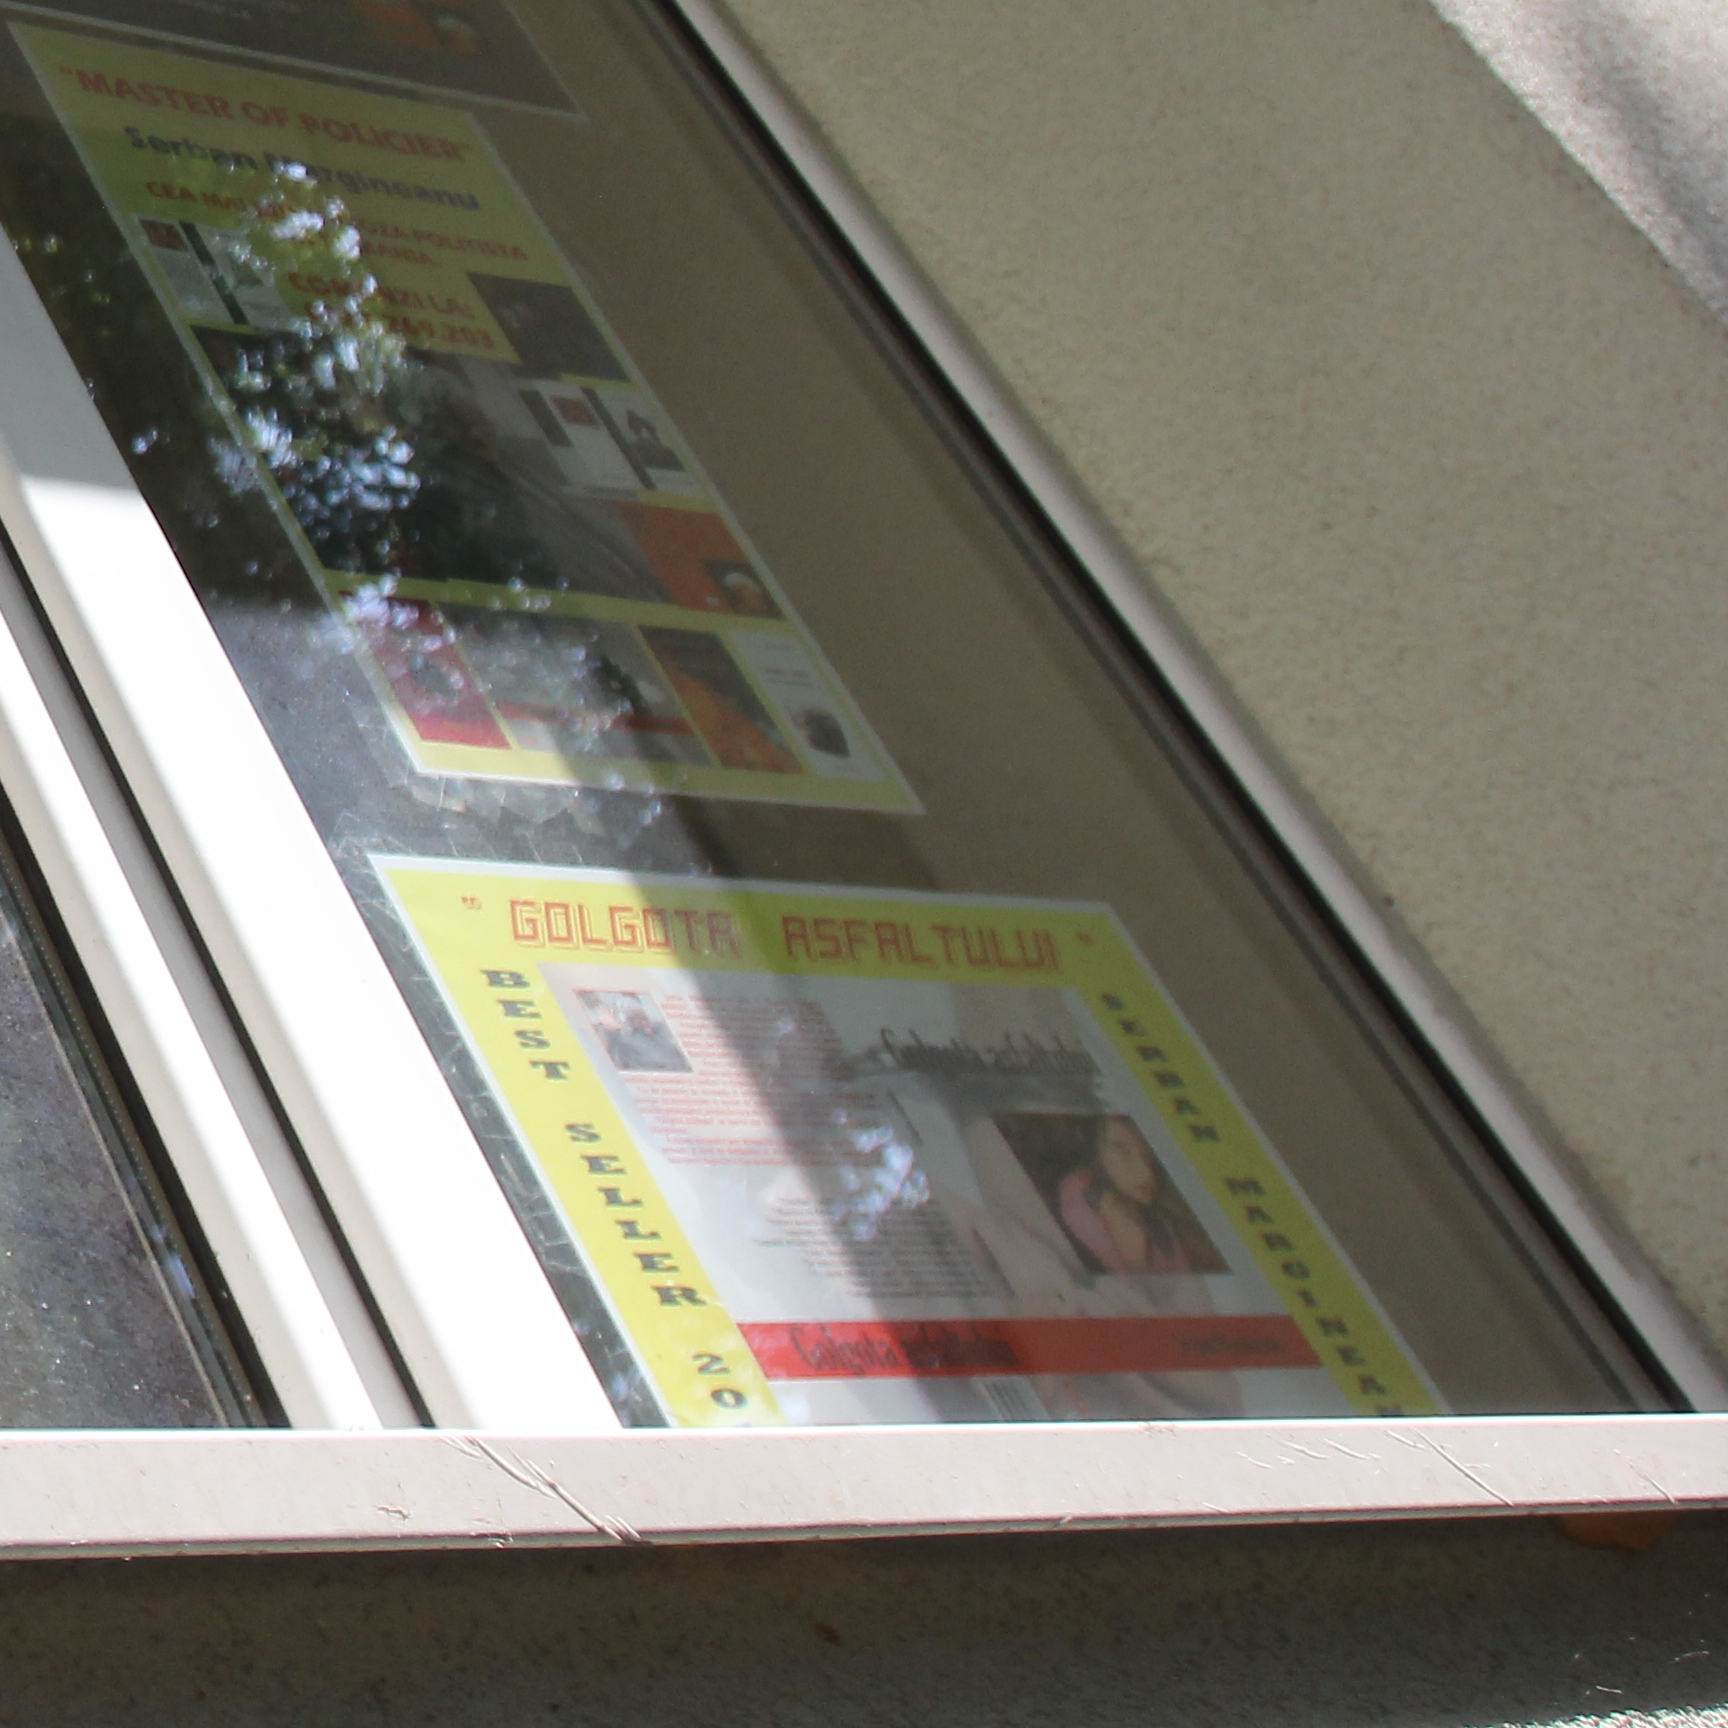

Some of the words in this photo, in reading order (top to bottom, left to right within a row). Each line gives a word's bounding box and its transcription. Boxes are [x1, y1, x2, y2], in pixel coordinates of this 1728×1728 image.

[240, 100, 289, 127] OF
[264, 151, 482, 211] Mrgineanu
[510, 898, 744, 960] GOLGOTA
[784, 914, 1065, 978] ASFALTULUI
[1101, 992, 1222, 1142] SERBAN
[480, 969, 572, 1082] BEST
[565, 1122, 708, 1308] SELLER
